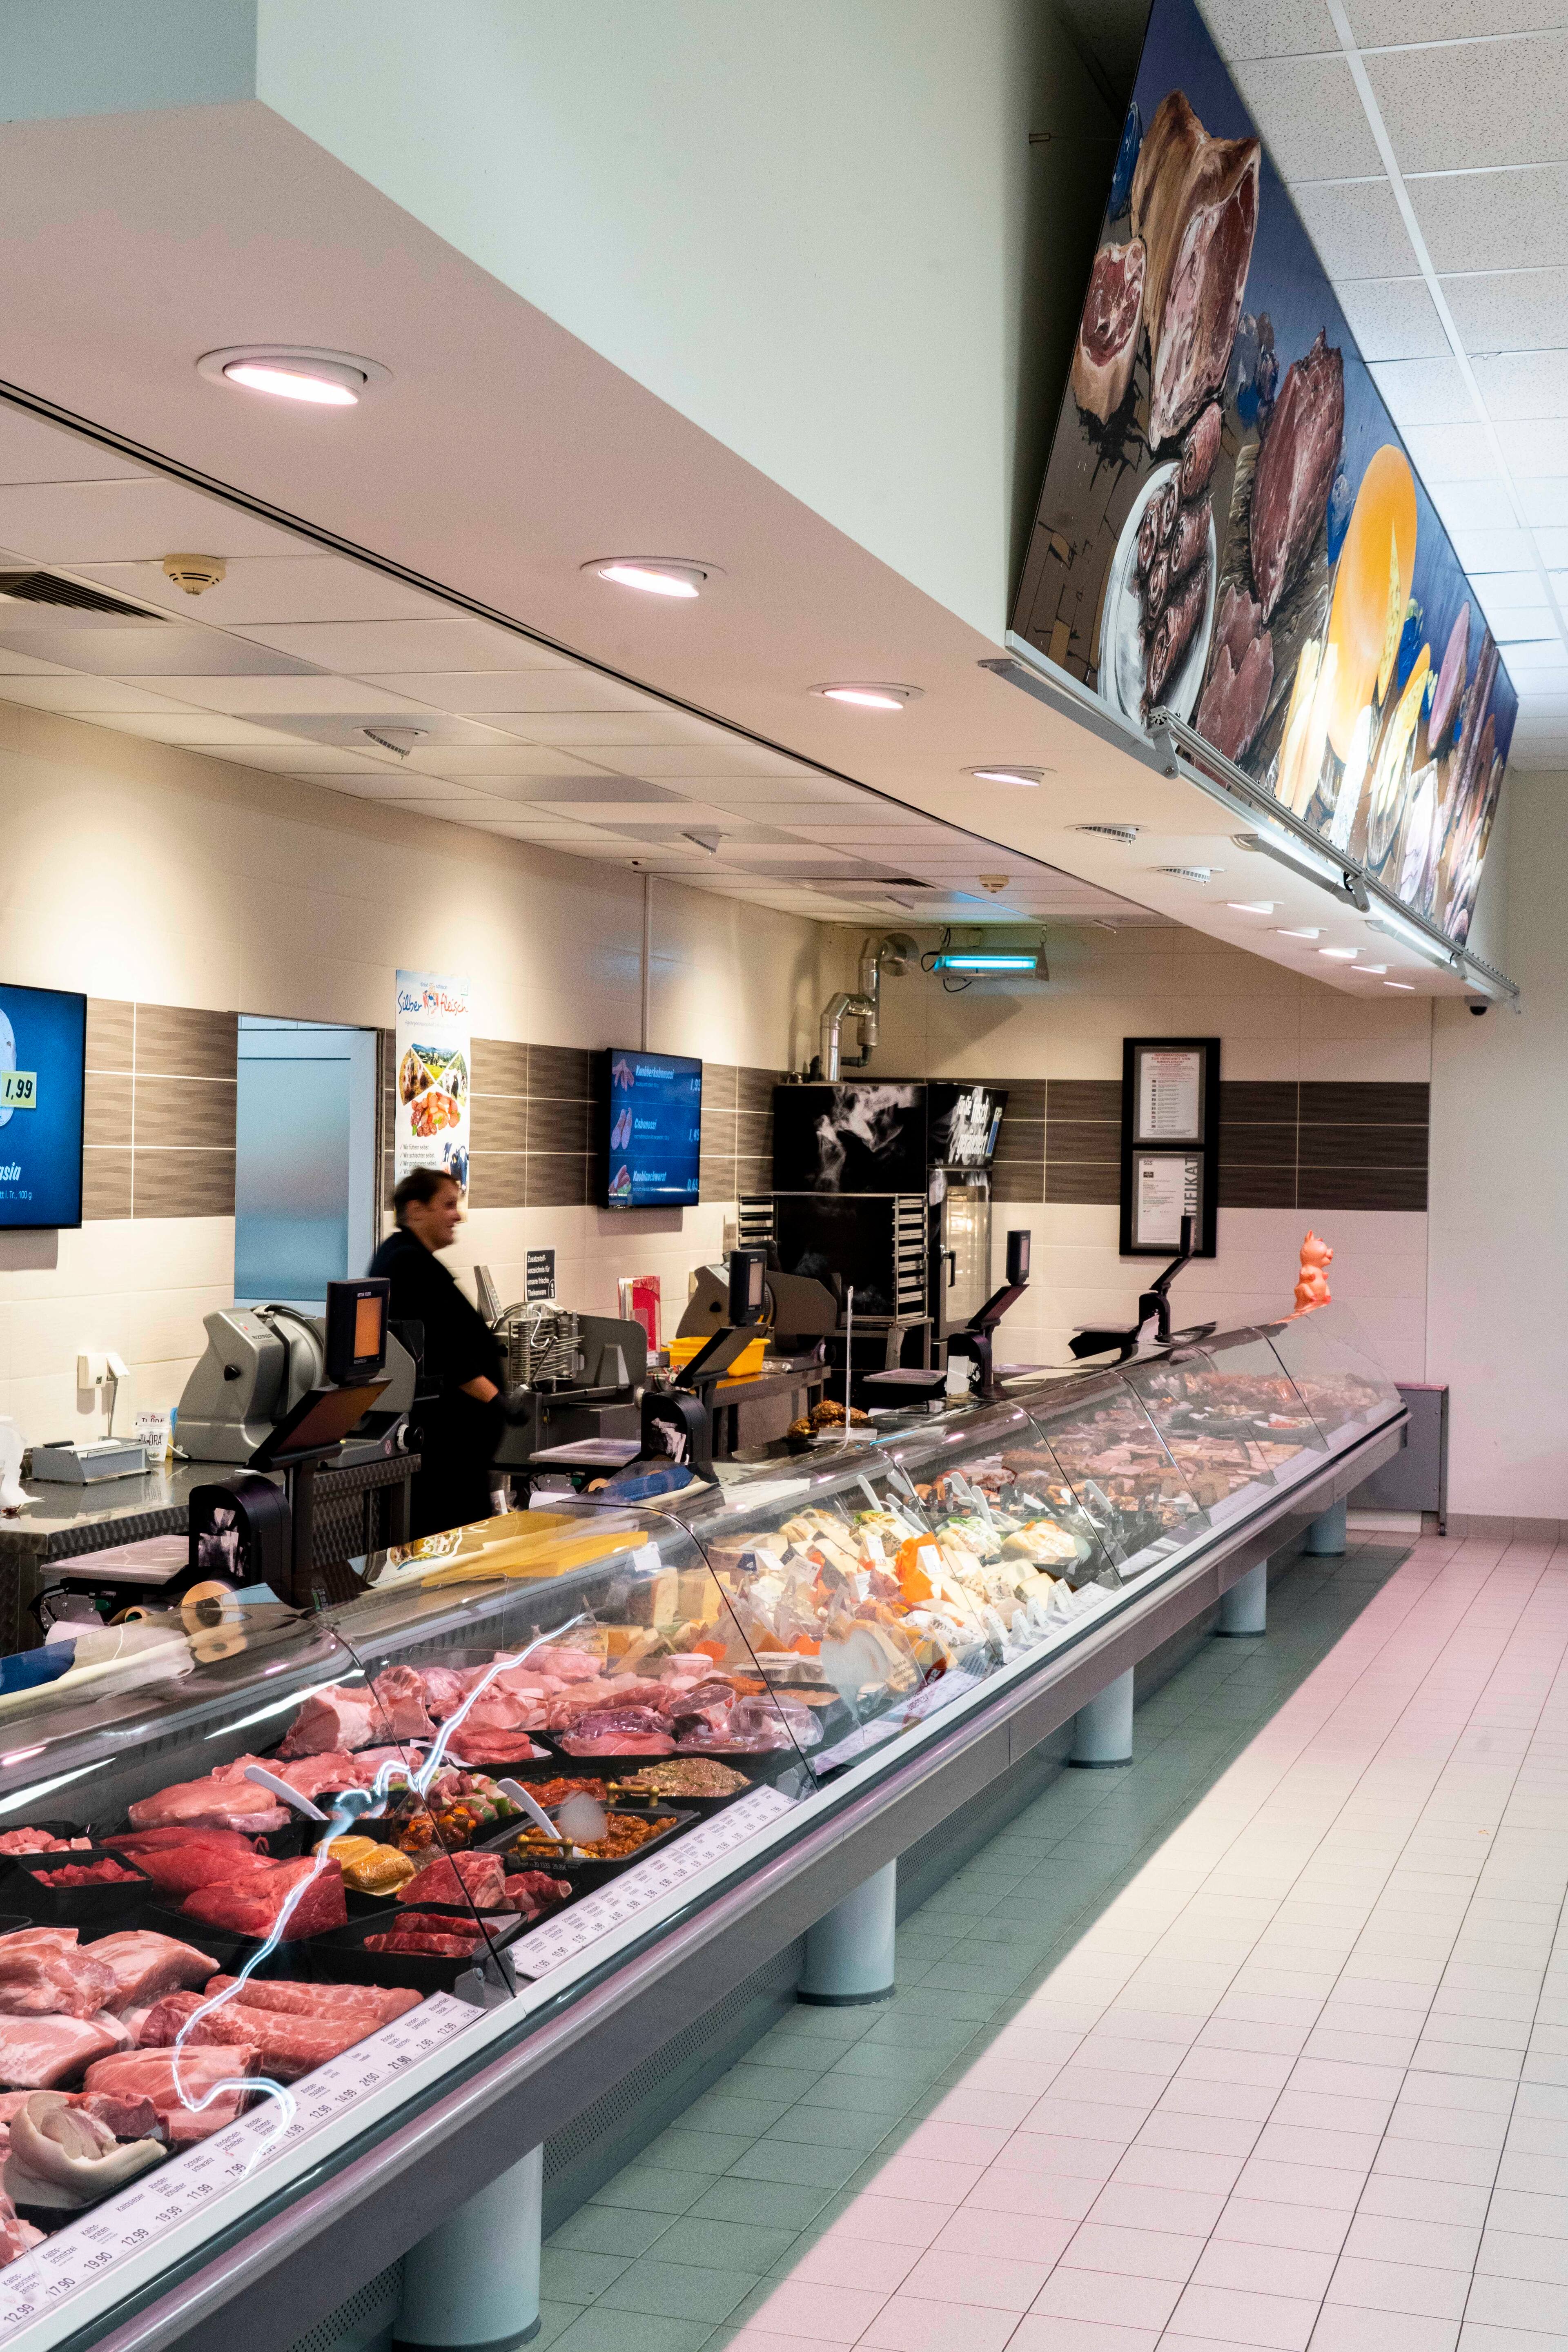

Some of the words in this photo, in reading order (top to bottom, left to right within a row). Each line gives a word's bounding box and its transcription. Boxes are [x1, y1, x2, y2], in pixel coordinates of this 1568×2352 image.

[398, 990, 422, 1014] Silber
[440, 993, 468, 1017] fleisch
[5, 1078, 33, 1100] 1,99
[970, 1097, 989, 1123] frisch
[634, 1118, 657, 1130] Cabanossi
[955, 1128, 989, 1163] geräuchert
[18, 1190, 27, 1199] 100
[28, 1192, 32, 1200] g
[527, 1254, 546, 1263] Zusatzstoff-
[673, 1868, 688, 1878] 10,99
[659, 1878, 673, 1887] 8,99
[644, 1889, 657, 1898] 3,99
[627, 1900, 641, 1909] 9,99
[609, 1911, 623, 1920] 8,49
[542, 1924, 559, 1936] Schweine-
[591, 1922, 605, 1932] 9,99
[523, 1937, 540, 1949] Schweine-
[572, 1934, 587, 1944] 9,99
[552, 1947, 569, 1958] 10,90
[532, 1960, 550, 1971] 11,99
[405, 2018, 419, 2027] Rinder-
[437, 2022, 457, 2035] 12,99
[380, 2033, 395, 2042] Rinder-
[388, 2038, 400, 2046] mark-
[416, 2038, 434, 2050] 2,99
[300, 2083, 317, 2094] Rinder-
[308, 2085, 327, 2097] roulade
[335, 2089, 357, 2103] 14,99
[310, 2105, 332, 2119] 12,99
[245, 2117, 263, 2129] Rinder-
[252, 2120, 272, 2132] schmor-
[259, 2124, 278, 2136] braten
[284, 2124, 305, 2138] 13,99
[214, 2131, 242, 2148] Rinderbein-
[223, 2137, 245, 2152] scheiben
[183, 2155, 205, 2169] Ochsen-
[192, 2157, 216, 2173] schwanz
[225, 2163, 247, 2177] 7,99
[148, 2177, 168, 2190] Rinder-
[156, 2183, 172, 2194] blatt-
[164, 2183, 187, 2198] schulter
[187, 2184, 213, 2200] 11,99
[116, 2193, 146, 2212] Kalbsleber
[155, 2206, 183, 2222] 19,99
[80, 2224, 99, 2236] Kalbs-
[88, 2226, 111, 2241] braten
[121, 2228, 149, 2246] 12,99
[41, 2247, 60, 2260] Kalbs-
[50, 2245, 78, 2265] schnitzel
[83, 2252, 113, 2270] 19,90
[1, 2273, 22, 2286] Kalbs-
[46, 2277, 76, 2296] 17,90
[4, 2303, 35, 2323] 12,99
